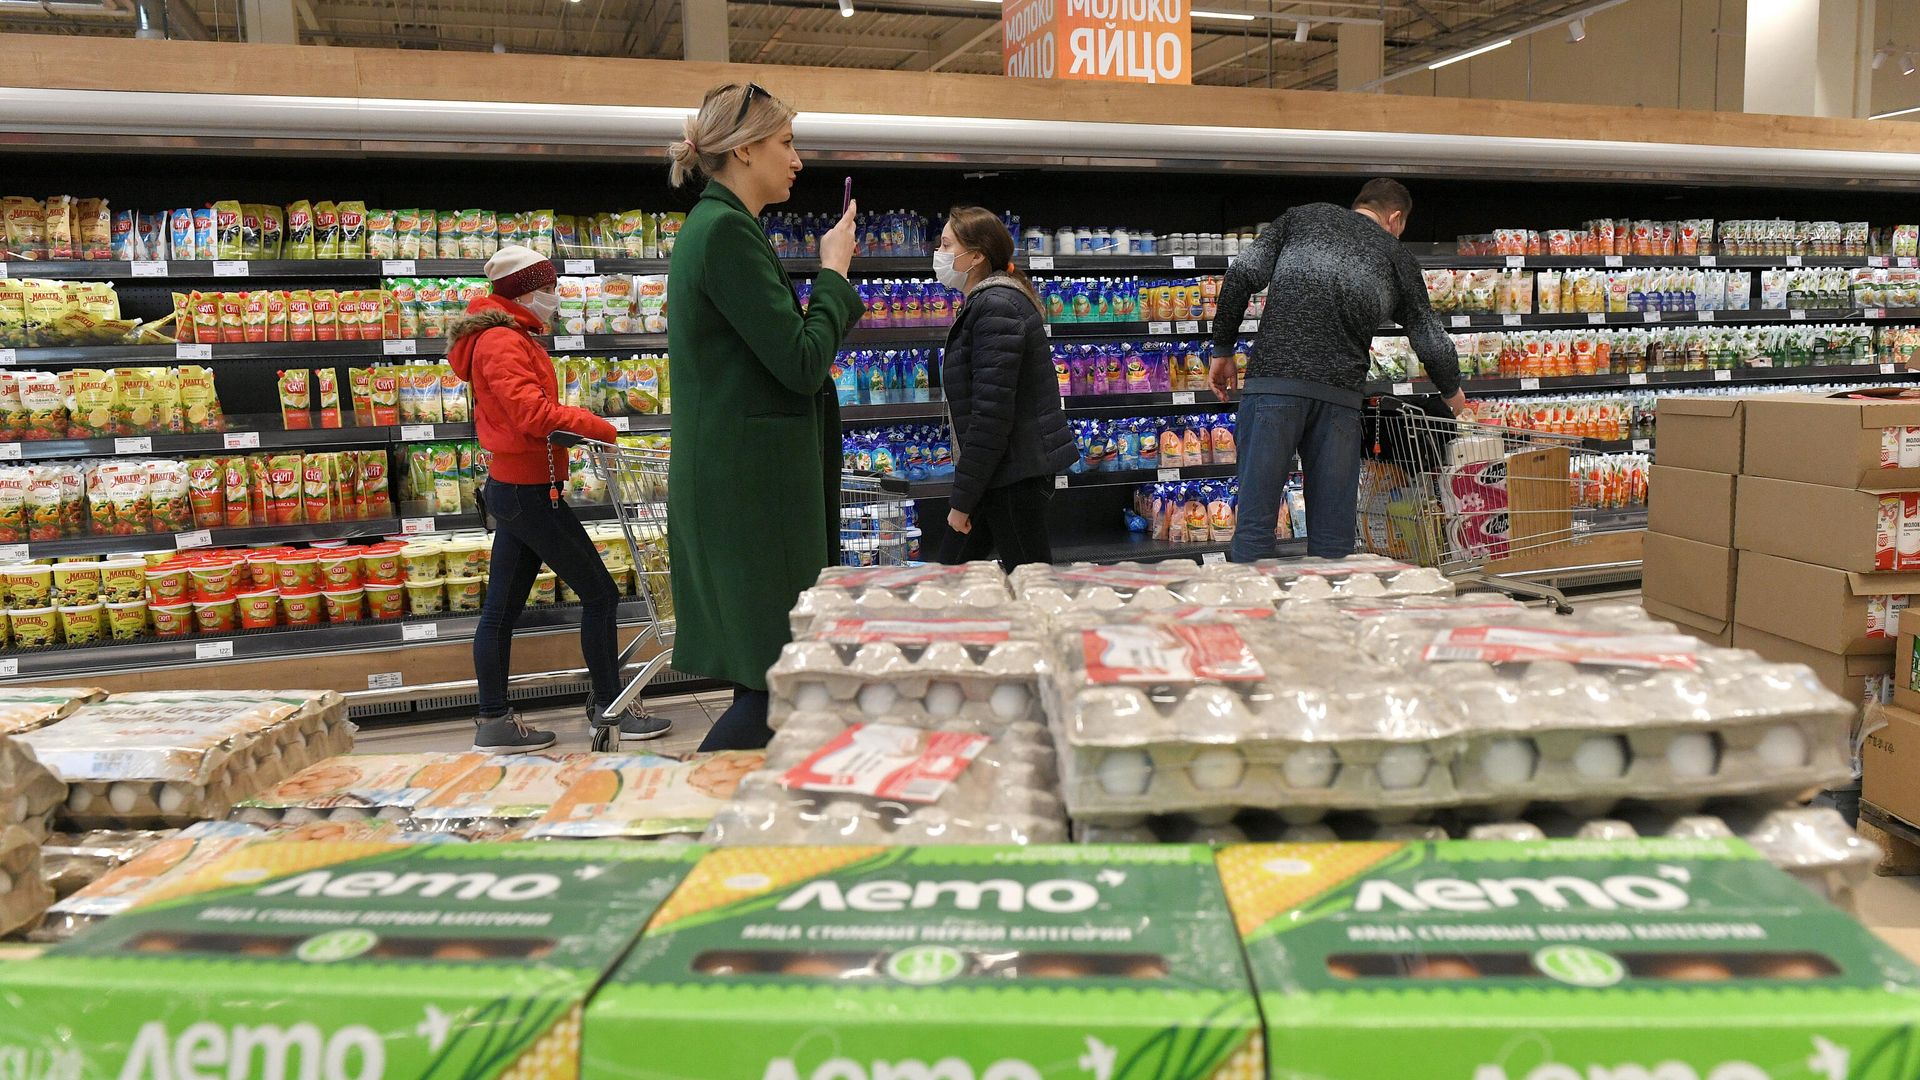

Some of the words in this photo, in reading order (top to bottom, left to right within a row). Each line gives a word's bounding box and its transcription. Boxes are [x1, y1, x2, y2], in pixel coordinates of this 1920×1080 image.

[1006, 0, 1054, 48] МОЛОКО
[1069, 22, 1182, 83] ЯЙЦО
[273, 470, 294, 482] СКИТ
